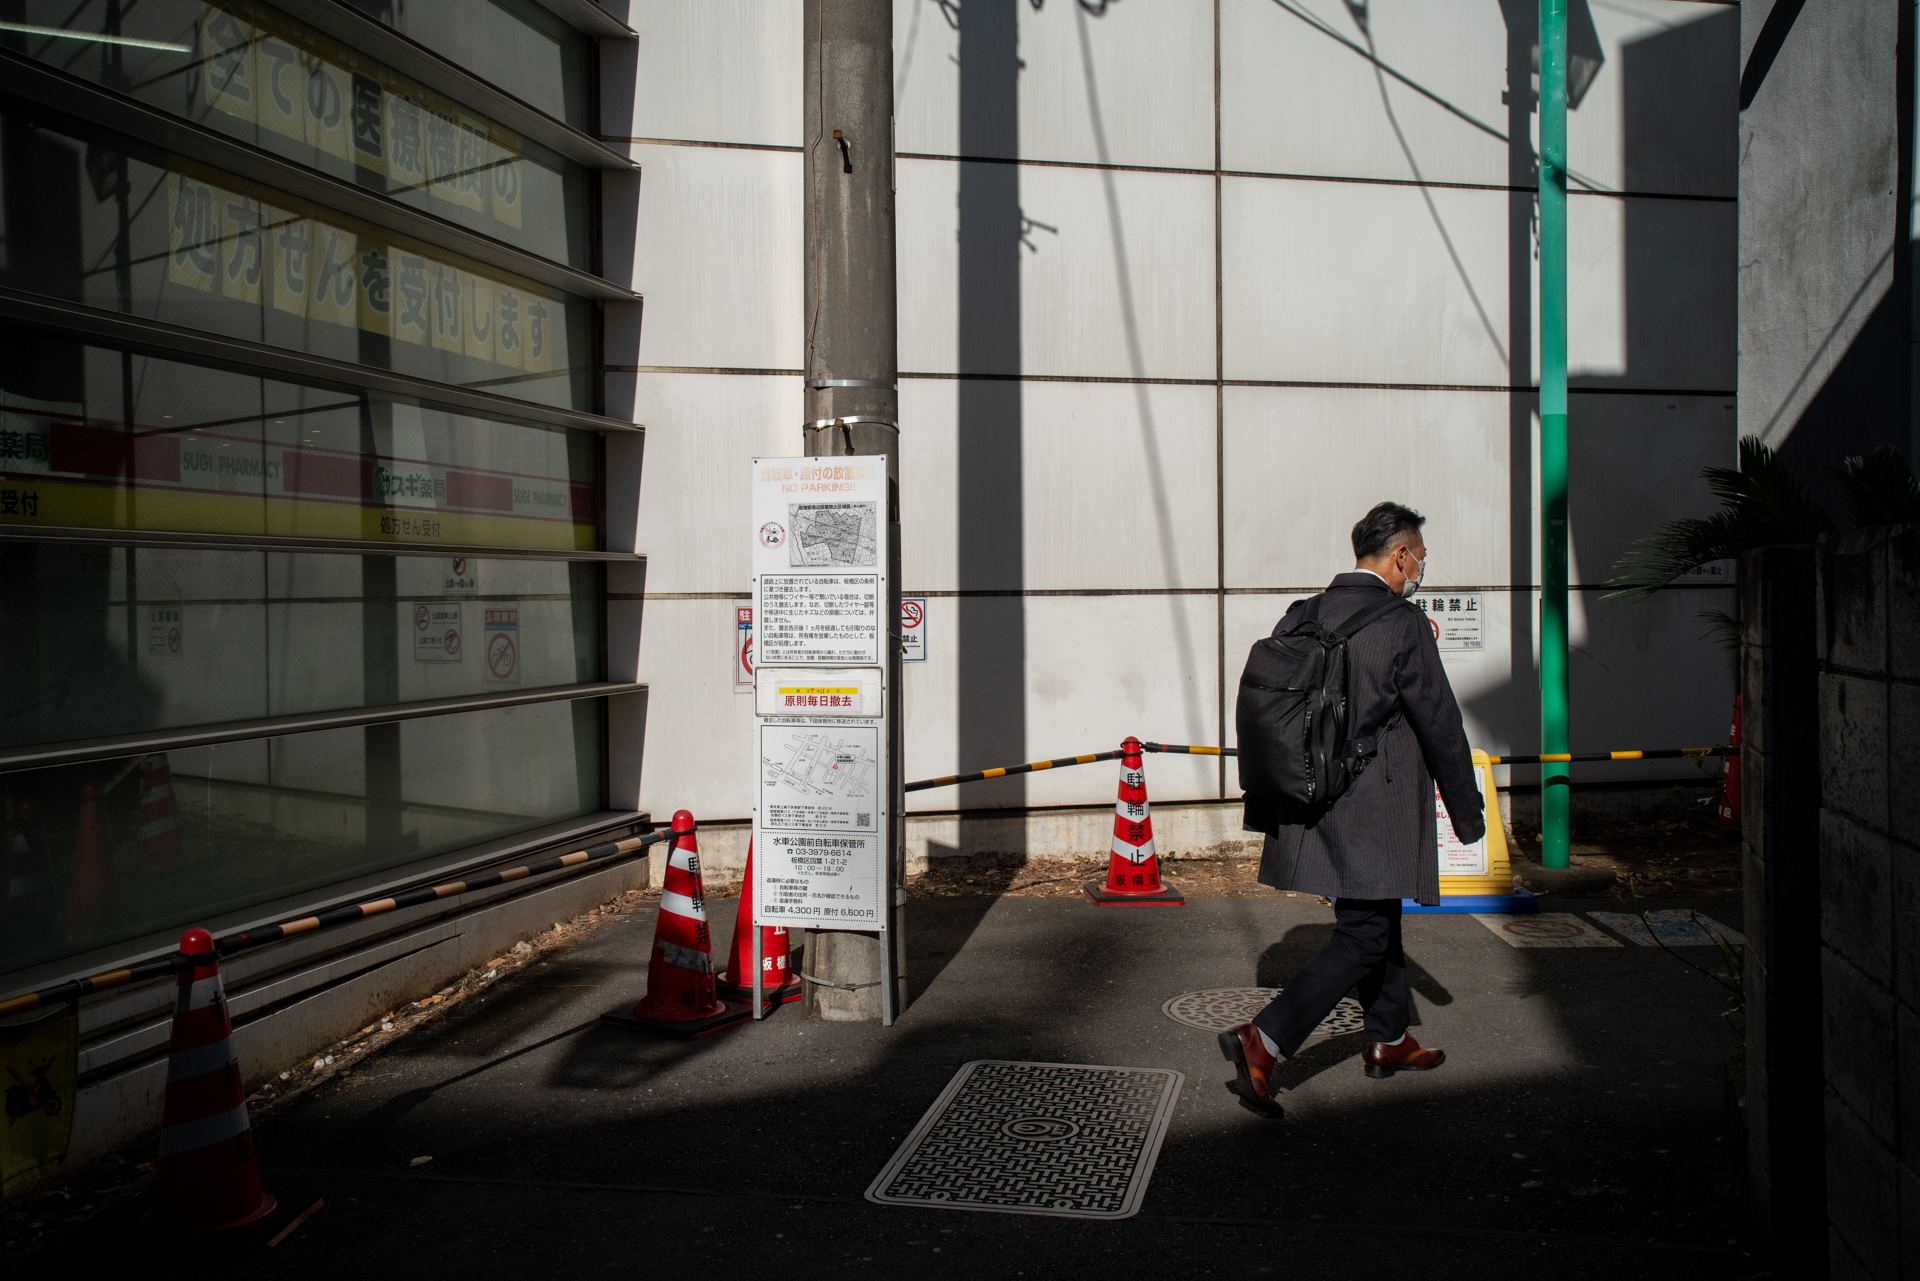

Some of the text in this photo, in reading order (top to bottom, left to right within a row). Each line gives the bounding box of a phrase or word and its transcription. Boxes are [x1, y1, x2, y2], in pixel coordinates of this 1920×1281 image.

[207, 5, 519, 206] 全ての医療機関の
[172, 172, 550, 359] 処方せんを受付します
[183, 451, 280, 479] SUGI PHARMACY
[391, 473, 446, 500] スギ薬局
[781, 482, 856, 492] NO PARKING!!
[0, 490, 38, 516] 受付
[380, 516, 441, 537] 処方せん受付
[785, 695, 852, 707] 原則毎日撤去
[1126, 773, 1146, 867] 駐輪禁止
[773, 837, 865, 849] 水車公園前自転車保管所
[791, 857, 823, 865] 板橋区四葉
[796, 848, 852, 857] 03-3979-6614
[1115, 874, 1158, 887] 板橋区
[764, 905, 786, 913] 自転車
[823, 907, 838, 916] 原付
